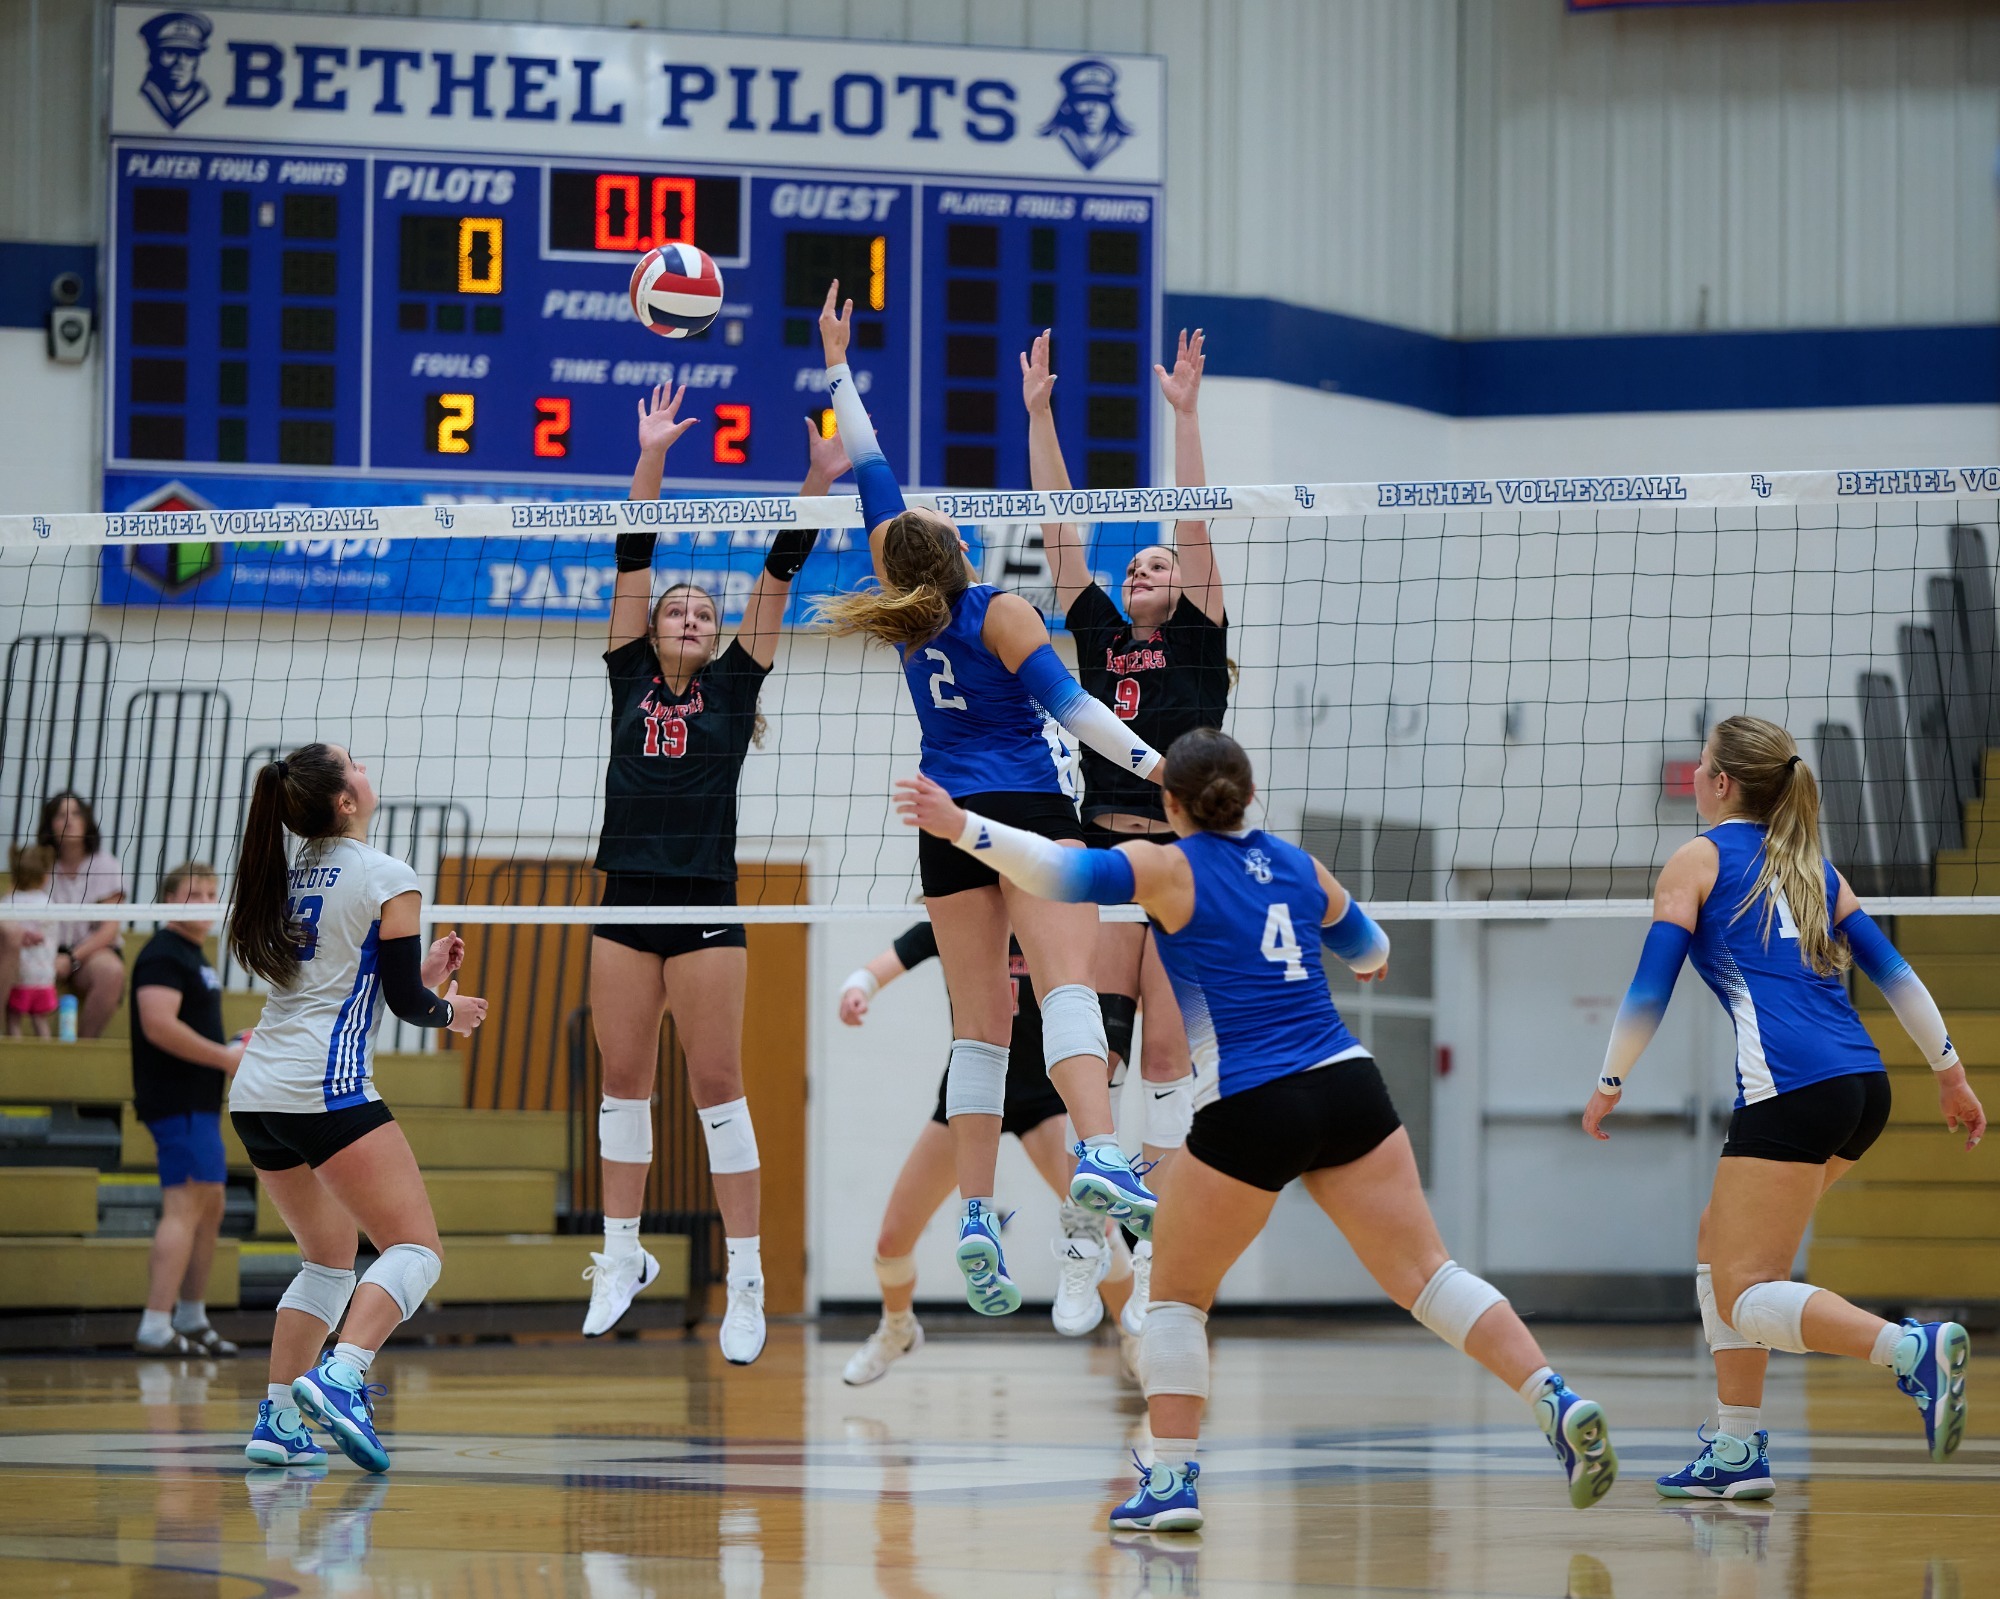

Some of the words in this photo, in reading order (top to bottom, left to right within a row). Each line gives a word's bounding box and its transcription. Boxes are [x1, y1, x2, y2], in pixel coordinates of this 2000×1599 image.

[224, 40, 626, 127] BETHEL
[661, 62, 1019, 144] PILOTS
[126, 153, 201, 180] PLAYER
[207, 158, 269, 184] FOULS
[277, 161, 348, 187] POINTS
[384, 165, 516, 205] PILOTS
[769, 183, 899, 222] GUEST
[938, 190, 1013, 216] PLAYER
[1015, 195, 1076, 221] FOULS
[1082, 199, 1150, 224] POINTS
[458, 217, 503, 294] 0
[869, 235, 886, 311] 1
[541, 289, 641, 323] PERIO
[410, 352, 492, 380] FOULS
[549, 357, 611, 385] TIME
[612, 359, 674, 387] OUTS
[676, 362, 739, 390] LEFT
[438, 393, 475, 454] 2
[534, 397, 571, 458] 2
[714, 404, 751, 464] 2
[1378, 480, 1493, 507] BETHEL
[1496, 476, 1688, 505] VOLLEYBALL
[1837, 469, 1957, 496] BETHEL
[512, 504, 617, 528] BETHEL
[620, 499, 797, 525] VOLLEYBALL
[936, 494, 1046, 518] BETHEL
[1049, 487, 1233, 514] VOLLEYBALL
[106, 513, 206, 537] BETHEL
[210, 509, 379, 534] VOLLEYBALL
[924, 647, 968, 711] 2
[1114, 677, 1141, 721] 9
[643, 716, 688, 758] 19
[287, 866, 342, 890] PILOTS
[1260, 902, 1309, 982] 4
